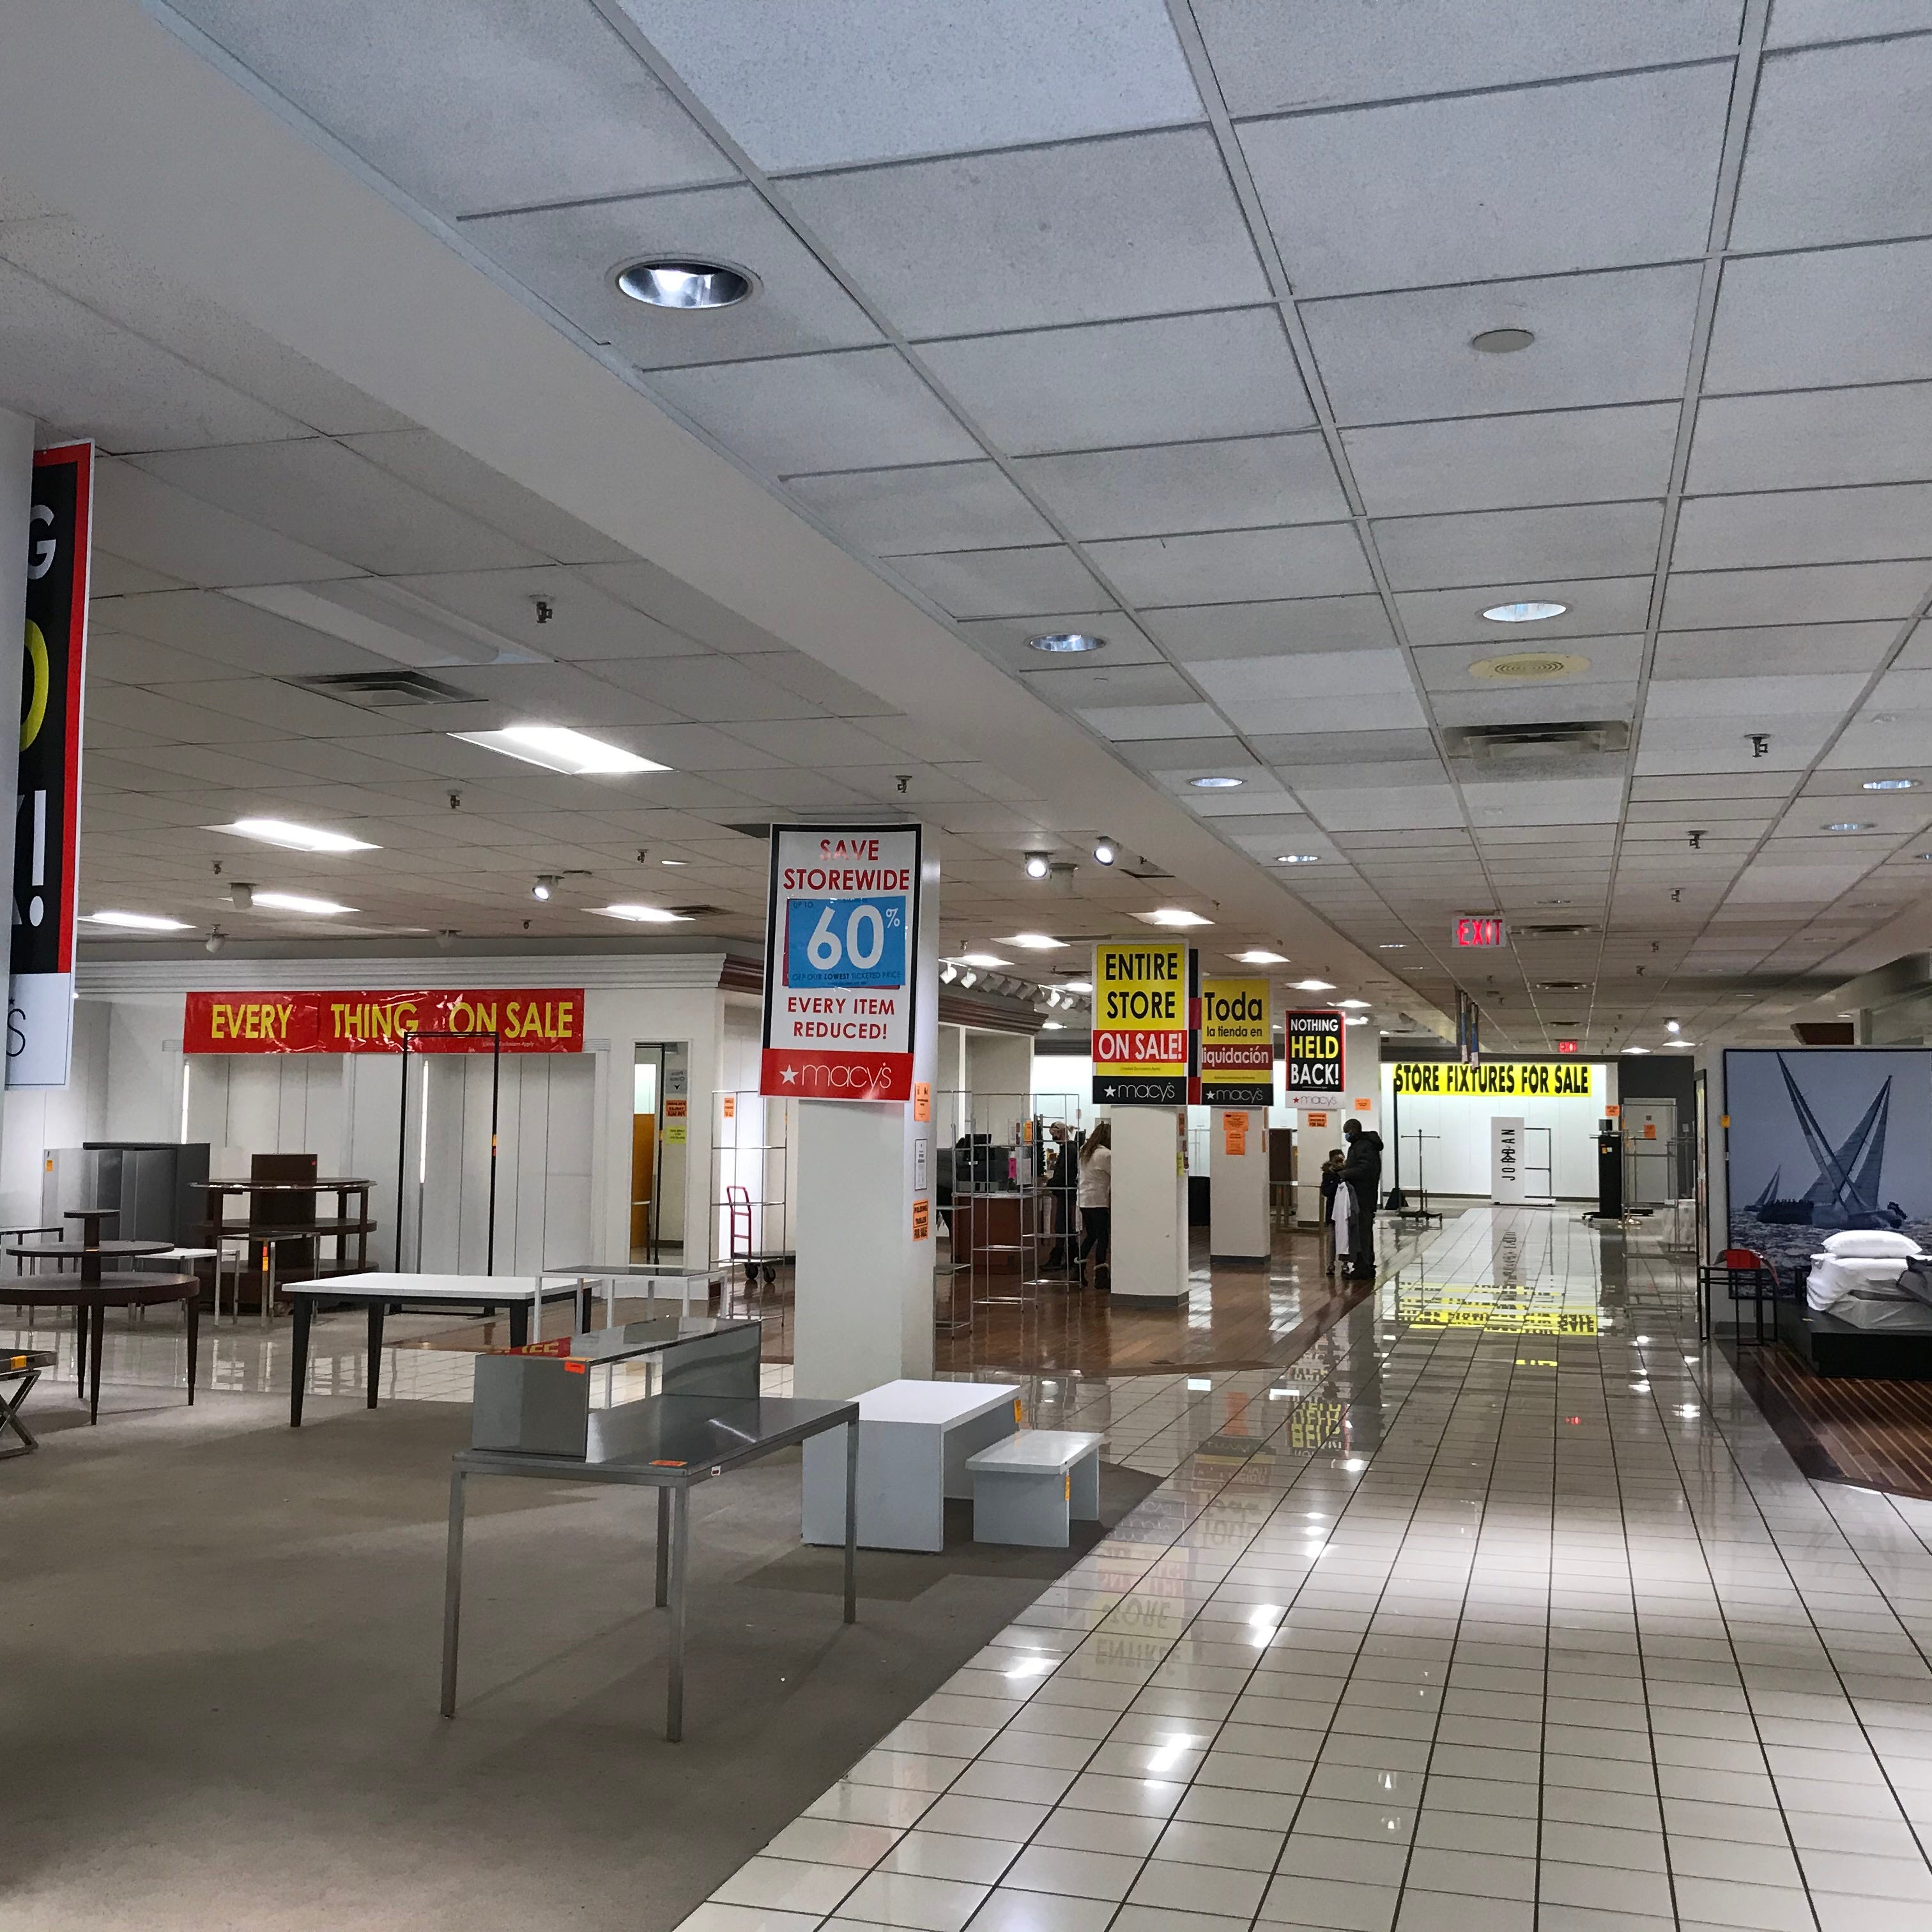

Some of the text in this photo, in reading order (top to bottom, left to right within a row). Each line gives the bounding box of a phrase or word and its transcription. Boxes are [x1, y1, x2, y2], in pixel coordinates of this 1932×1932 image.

[820, 839, 879, 861] SAVE
[783, 868, 910, 891] STOREWIDE
[1458, 918, 1503, 946] EXIT
[1105, 953, 1177, 980] ENTIRE
[787, 997, 895, 1015] EVERY ITEM
[1107, 991, 1176, 1019] STORE
[1204, 992, 1262, 1021] Toda
[211, 1002, 573, 1039] EVERY THING ON SALE
[793, 1021, 887, 1039] REDUCED!
[1207, 1025, 1262, 1037] la tienda en
[1291, 1018, 1338, 1032] NOTHING
[1098, 1032, 1182, 1060] ON SALE!
[1202, 1046, 1269, 1067] liquidación
[1291, 1036, 1338, 1059] HELD
[801, 1062, 893, 1094] macy's
[1291, 1063, 1338, 1085] BACK!
[1395, 1064, 1588, 1094] STORE FIXTURES FOR SALE
[1118, 1082, 1175, 1101] macy's
[1216, 1087, 1263, 1103] macy's
[1501, 1129, 1515, 1181] JORDAN
